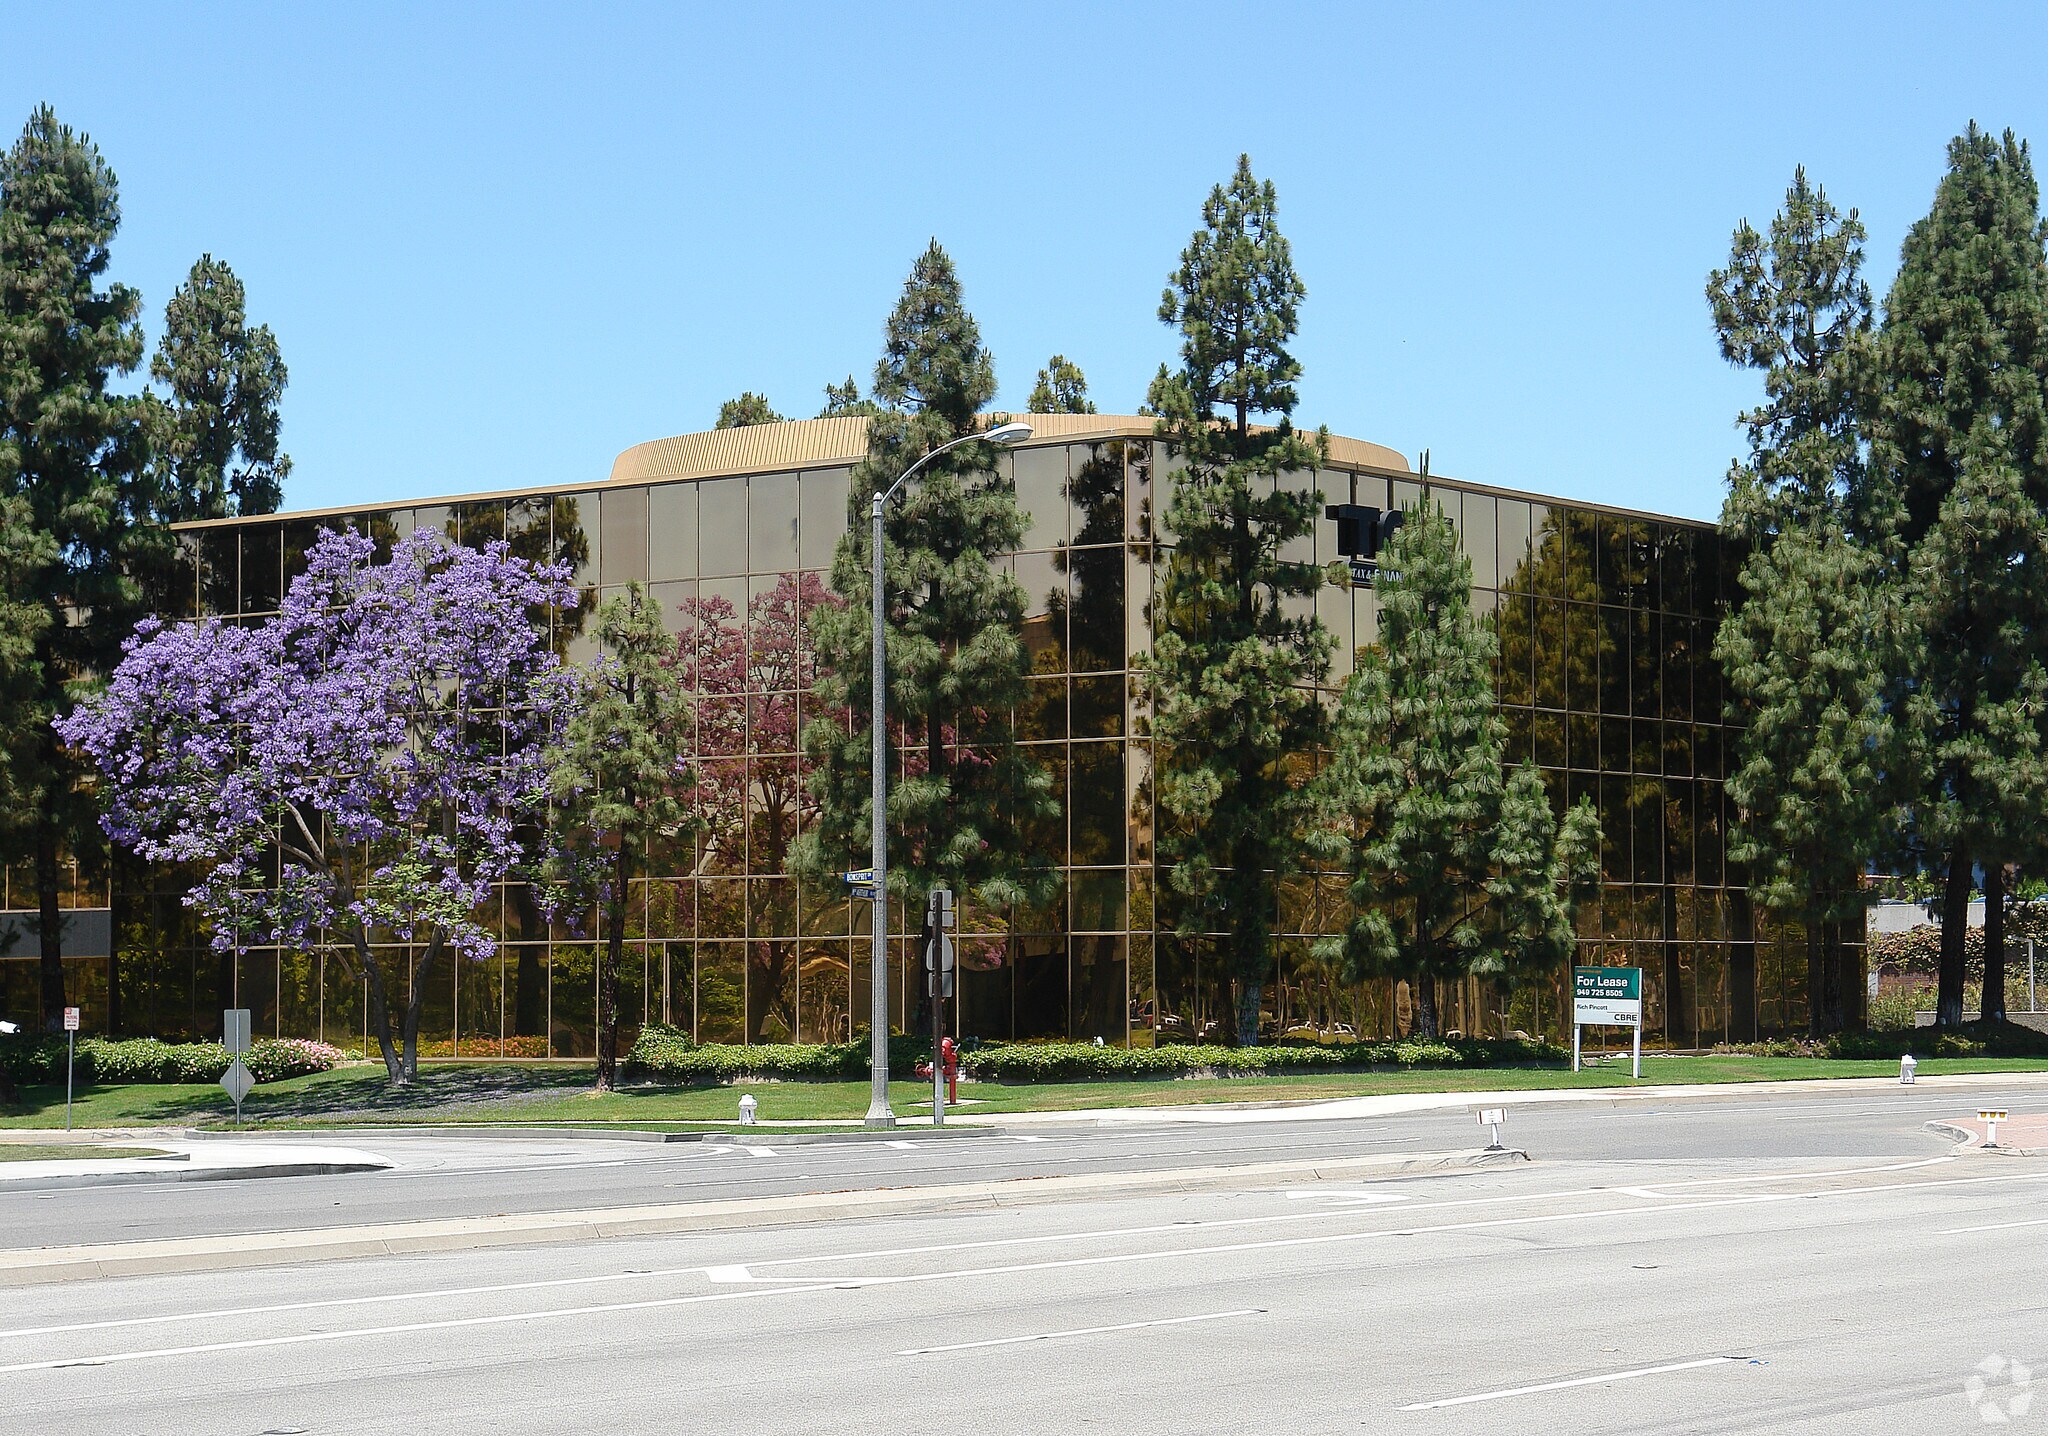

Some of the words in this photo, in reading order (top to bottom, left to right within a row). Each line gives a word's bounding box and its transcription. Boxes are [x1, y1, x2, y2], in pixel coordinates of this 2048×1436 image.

[1352, 567, 1366, 579] TAX
[1577, 975, 1595, 987] For
[1597, 975, 1628, 987] Lease
[1576, 988, 1590, 996] 949
[1591, 989, 1605, 997] 725
